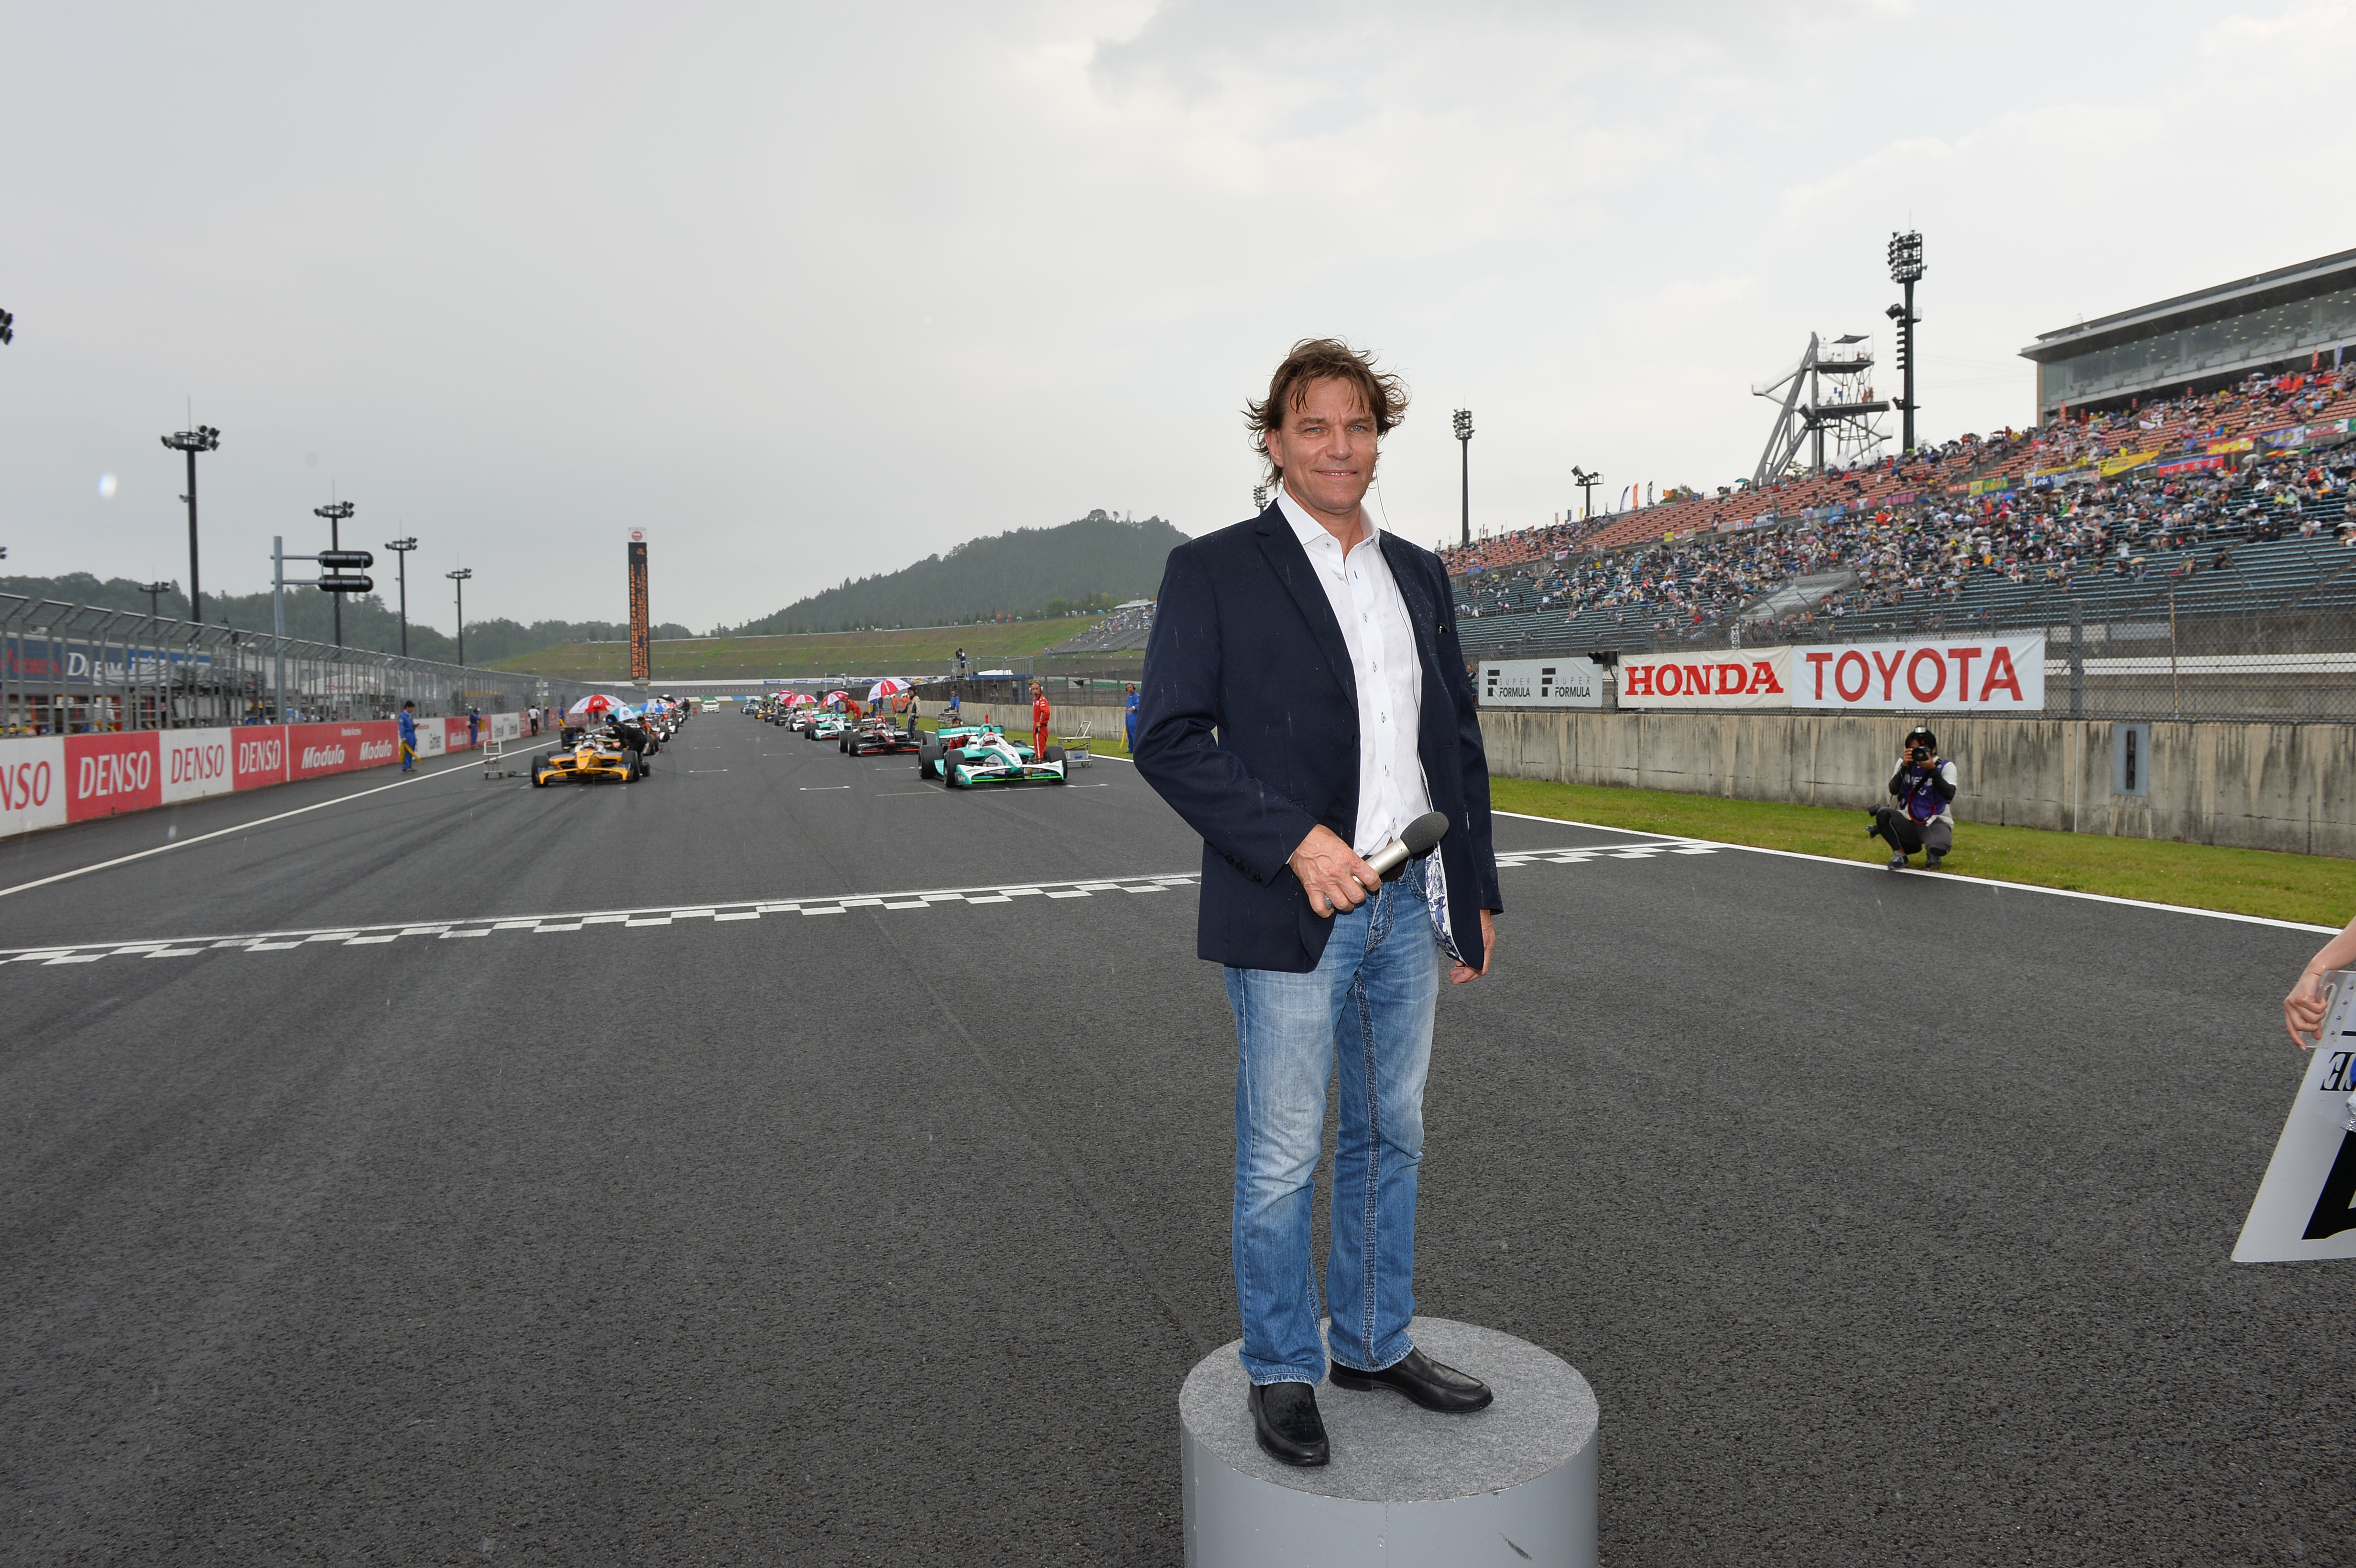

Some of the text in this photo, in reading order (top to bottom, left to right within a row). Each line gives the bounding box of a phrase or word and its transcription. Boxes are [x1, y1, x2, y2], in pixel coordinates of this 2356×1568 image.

[1555, 686, 1591, 697] FORMULA
[1625, 661, 1784, 696] HONDA
[1806, 646, 2023, 703] TOYOTA
[1499, 687, 1530, 697] FORMULA
[171, 744, 224, 784] DENSO
[239, 740, 281, 774] DENSO
[301, 744, 345, 769] Modulo
[360, 740, 393, 761] Modulo
[78, 751, 152, 799] DENSO
